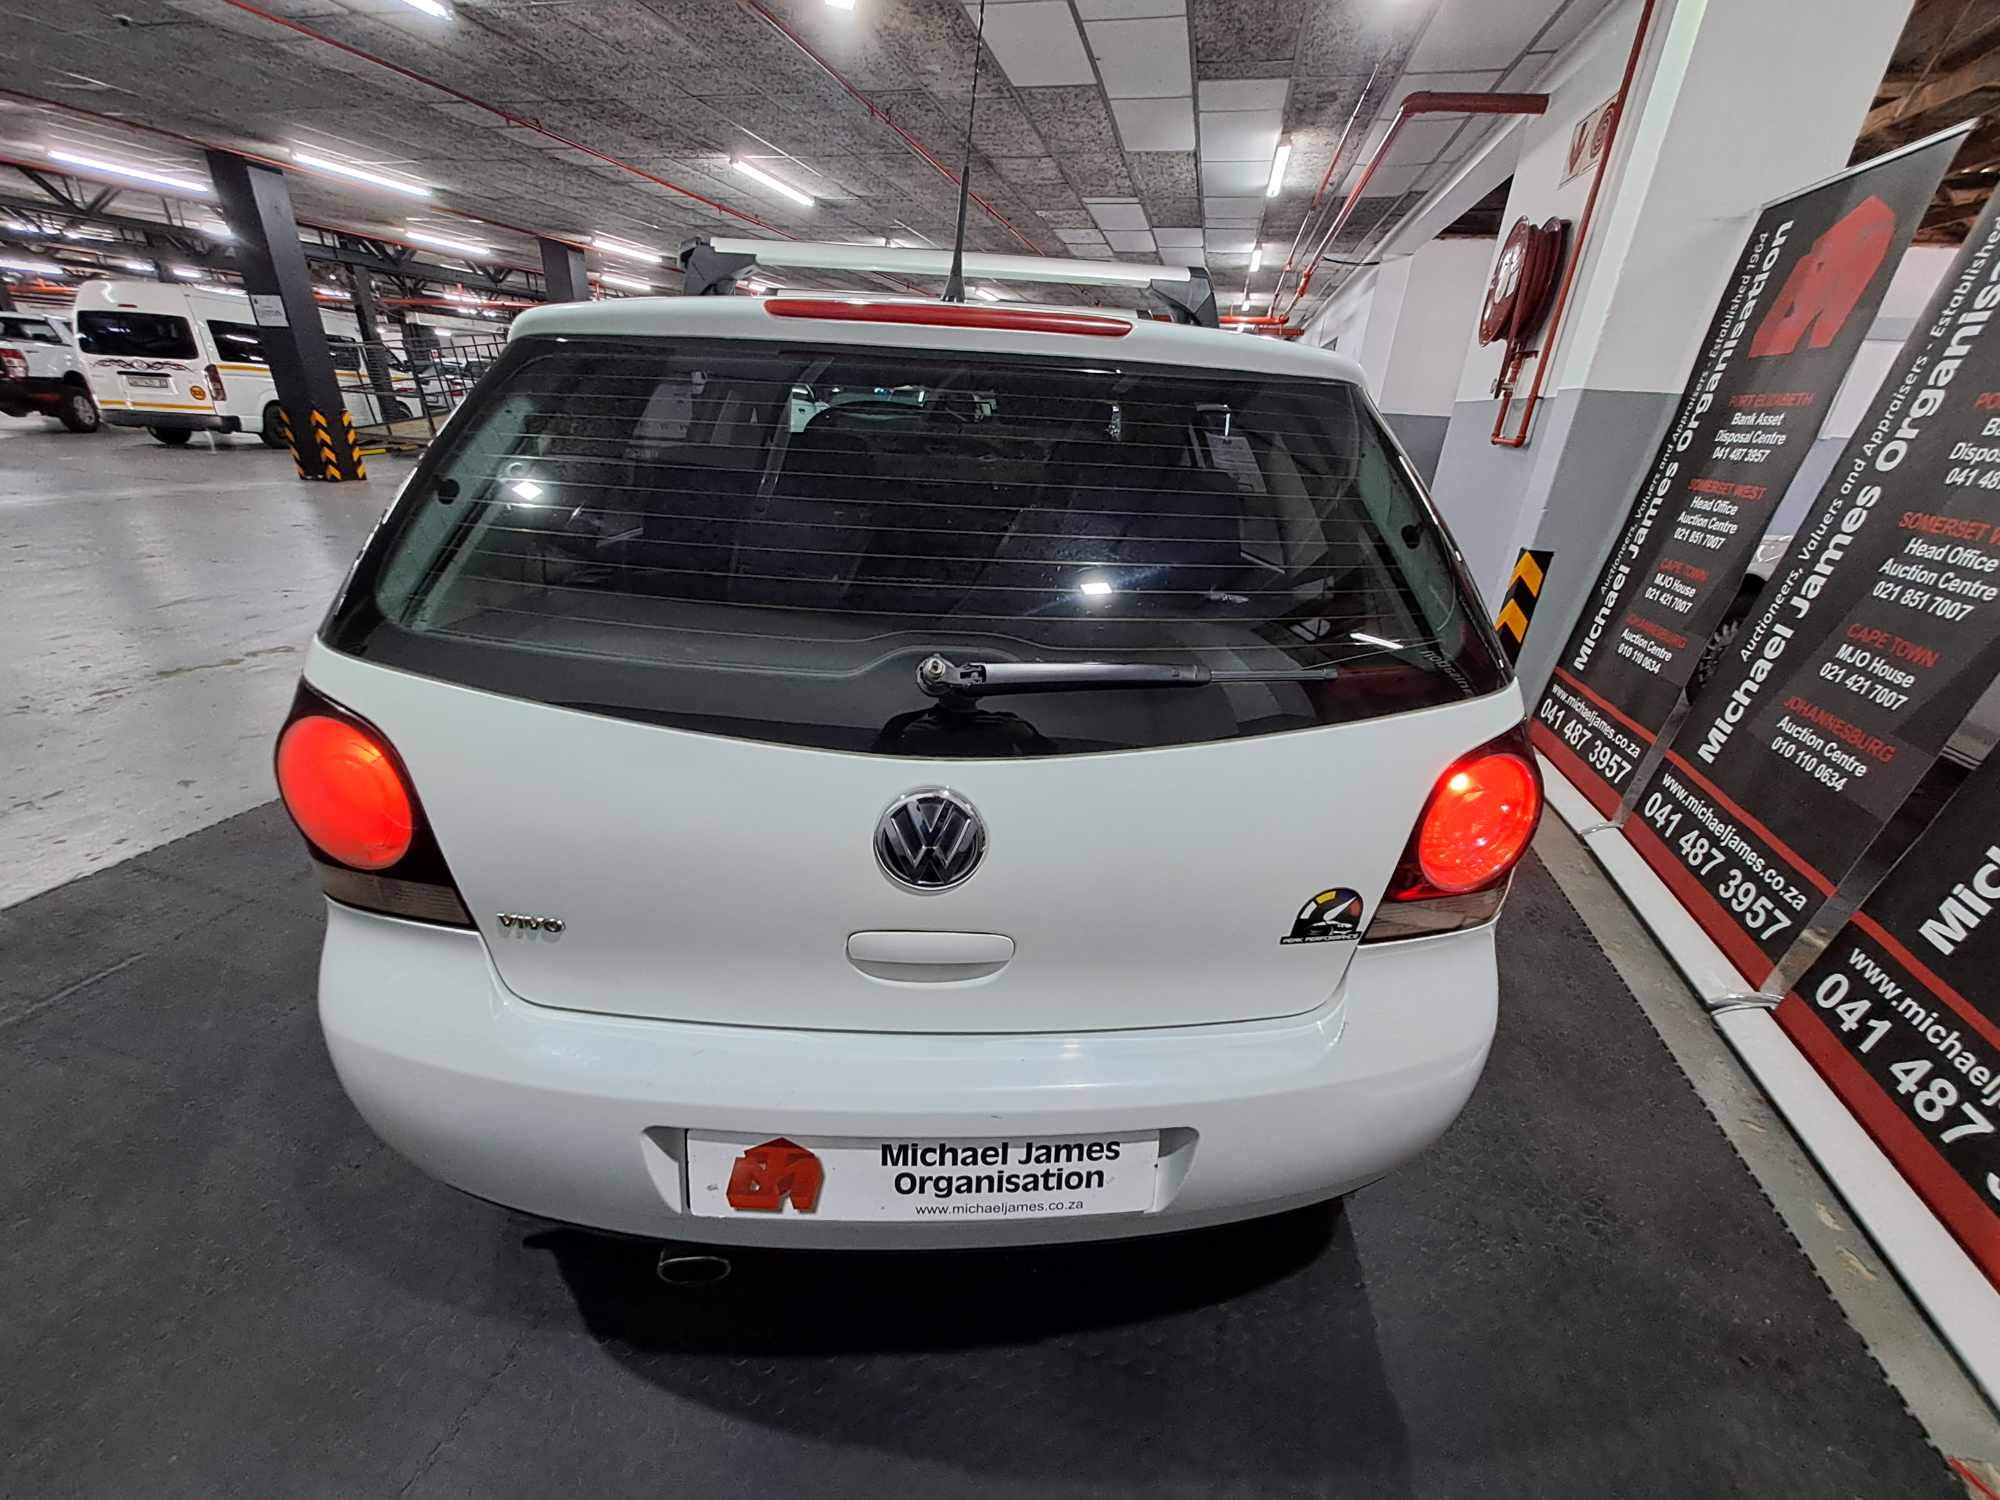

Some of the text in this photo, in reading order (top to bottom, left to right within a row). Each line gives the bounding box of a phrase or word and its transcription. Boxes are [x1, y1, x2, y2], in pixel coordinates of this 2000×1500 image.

[1635, 473, 1662, 518] Valuers
[1659, 444, 1674, 470] and
[1672, 371, 1709, 442] Appraisers
[1709, 275, 1751, 358] Established
[1746, 232, 1769, 271] 1964
[1715, 430, 1787, 446] Disposal Centre
[1731, 412, 1786, 426] Bank Asset
[1573, 220, 1794, 671] Michael James Organisation
[1712, 447, 1731, 460] 041
[1945, 467, 2000, 490] 041 48
[1677, 511, 1739, 534] Auction Centre
[1690, 496, 1739, 516] Head Office
[1697, 260, 2000, 764] Michael James Organis
[1739, 568, 1803, 662] Auctioneers,
[1798, 498, 1842, 560] Valuers
[1840, 458, 1867, 495] and
[1863, 354, 1928, 457] Appraisers
[1899, 511, 1991, 540] SOMERSET
[1904, 537, 1999, 572] Head Office
[1671, 579, 1697, 598] House
[1873, 580, 1975, 622] 021 851 7007
[1879, 557, 1998, 601] Auction Centre
[1621, 628, 1673, 662] Auction Centre
[1835, 643, 1915, 688] MJO House
[1846, 623, 1941, 668] CAPE TOWN
[1820, 662, 1910, 711] 021 421 7007
[1540, 698, 1632, 784] 041 487 3957
[1552, 683, 1641, 759] www.michaeljames.co.za
[1771, 736, 1849, 792] 010 110 0634
[1776, 715, 1868, 777] Auction Centre
[1662, 773, 1807, 911] www.michaeljames.co.za
[1644, 792, 1793, 941] 041 487 3957
[497, 912, 566, 932] VIVO
[1918, 845, 2000, 956] Mic
[1815, 973, 1996, 1144] 041 487
[881, 1140, 1121, 1167] Michael James
[894, 1168, 1105, 1198] Organisation
[915, 1200, 1084, 1216] www.michaeljames.co.za
